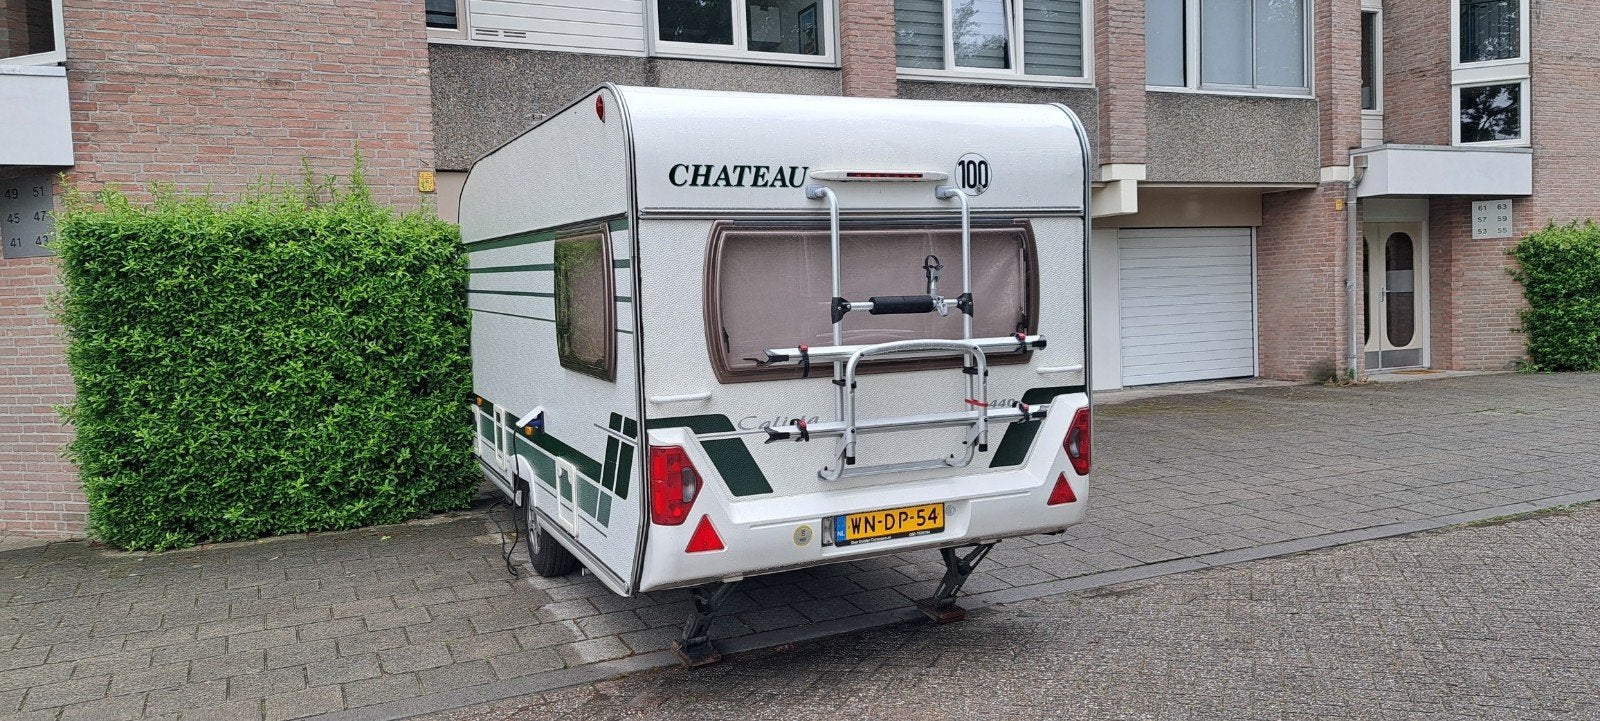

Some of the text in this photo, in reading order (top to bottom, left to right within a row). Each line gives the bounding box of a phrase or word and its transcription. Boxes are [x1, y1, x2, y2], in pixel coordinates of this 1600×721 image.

[668, 163, 809, 188] CHATEAU
[958, 160, 989, 189] 100
[4, 186, 45, 200] 49 51
[6, 210, 46, 224] 45 47
[10, 237, 22, 248] 41
[737, 415, 820, 431] Calia
[851, 507, 938, 535] WN-DP-54
